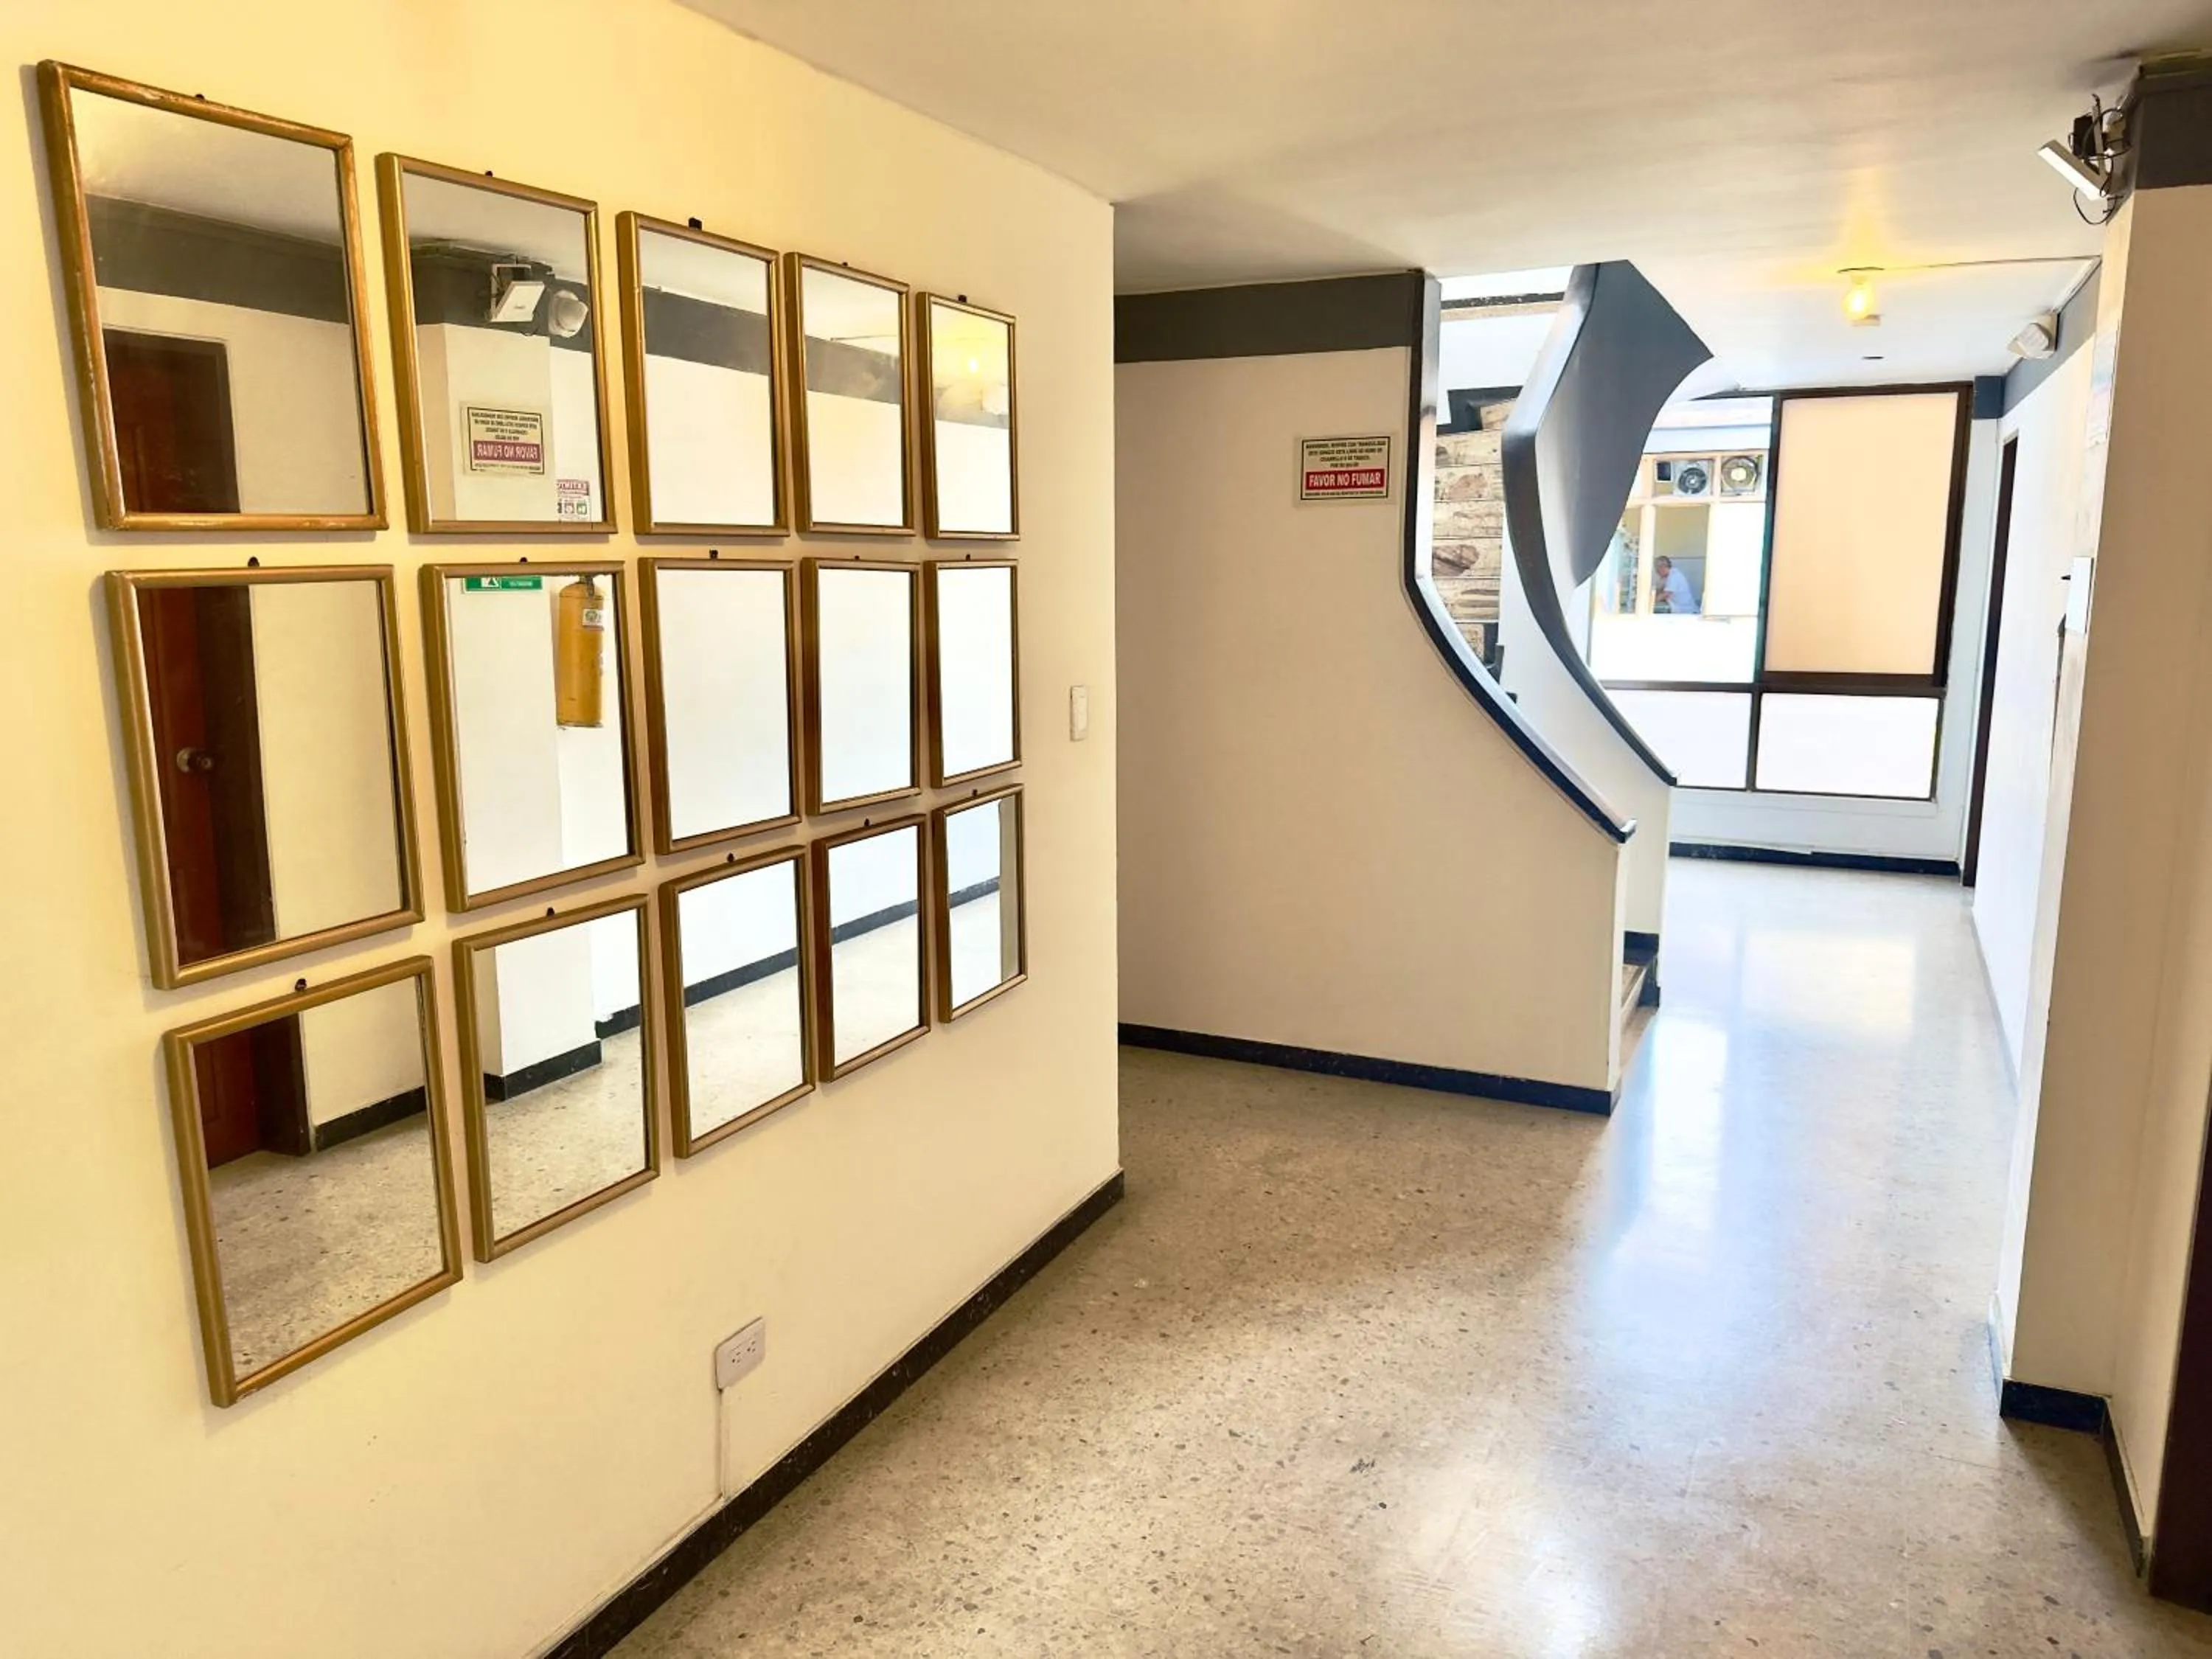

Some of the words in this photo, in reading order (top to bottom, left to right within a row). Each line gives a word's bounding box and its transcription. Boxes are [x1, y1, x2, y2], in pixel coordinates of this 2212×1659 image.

[1309, 474, 1335, 487] FAVOR
[1337, 473, 1349, 486] NO
[1352, 472, 1381, 485] FUMAR
